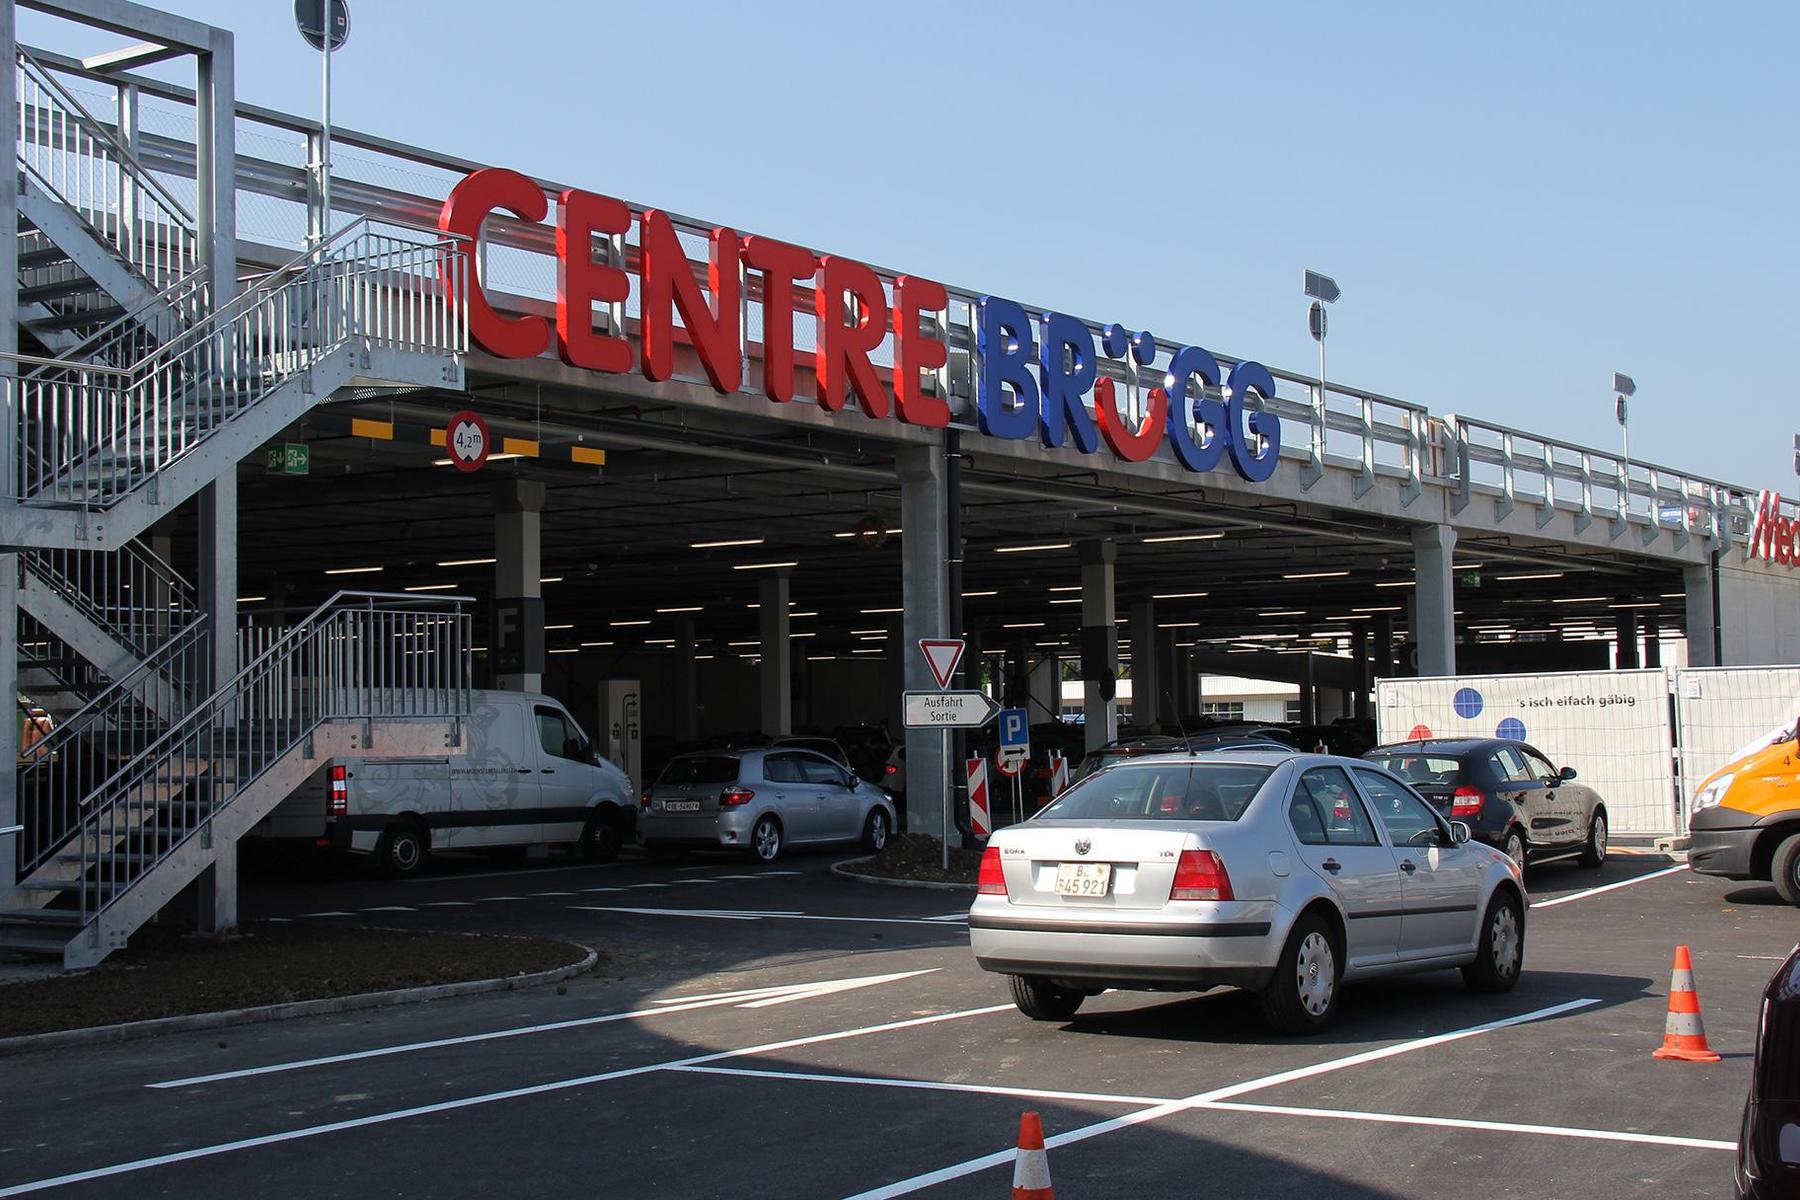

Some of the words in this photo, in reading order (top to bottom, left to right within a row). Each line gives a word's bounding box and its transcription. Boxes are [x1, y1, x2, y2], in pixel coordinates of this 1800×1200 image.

[437, 168, 951, 429] CENTRE
[977, 295, 1281, 482] BRÜGG
[498, 607, 518, 649] F
[924, 697, 963, 708] Ausfahrt
[1529, 697, 1553, 708] isch
[1556, 695, 1595, 706] eifach
[1598, 694, 1636, 708] gäbig
[930, 711, 957, 722] Sortie
[1006, 715, 1021, 742] P
[1783, 755, 1791, 767] 4
